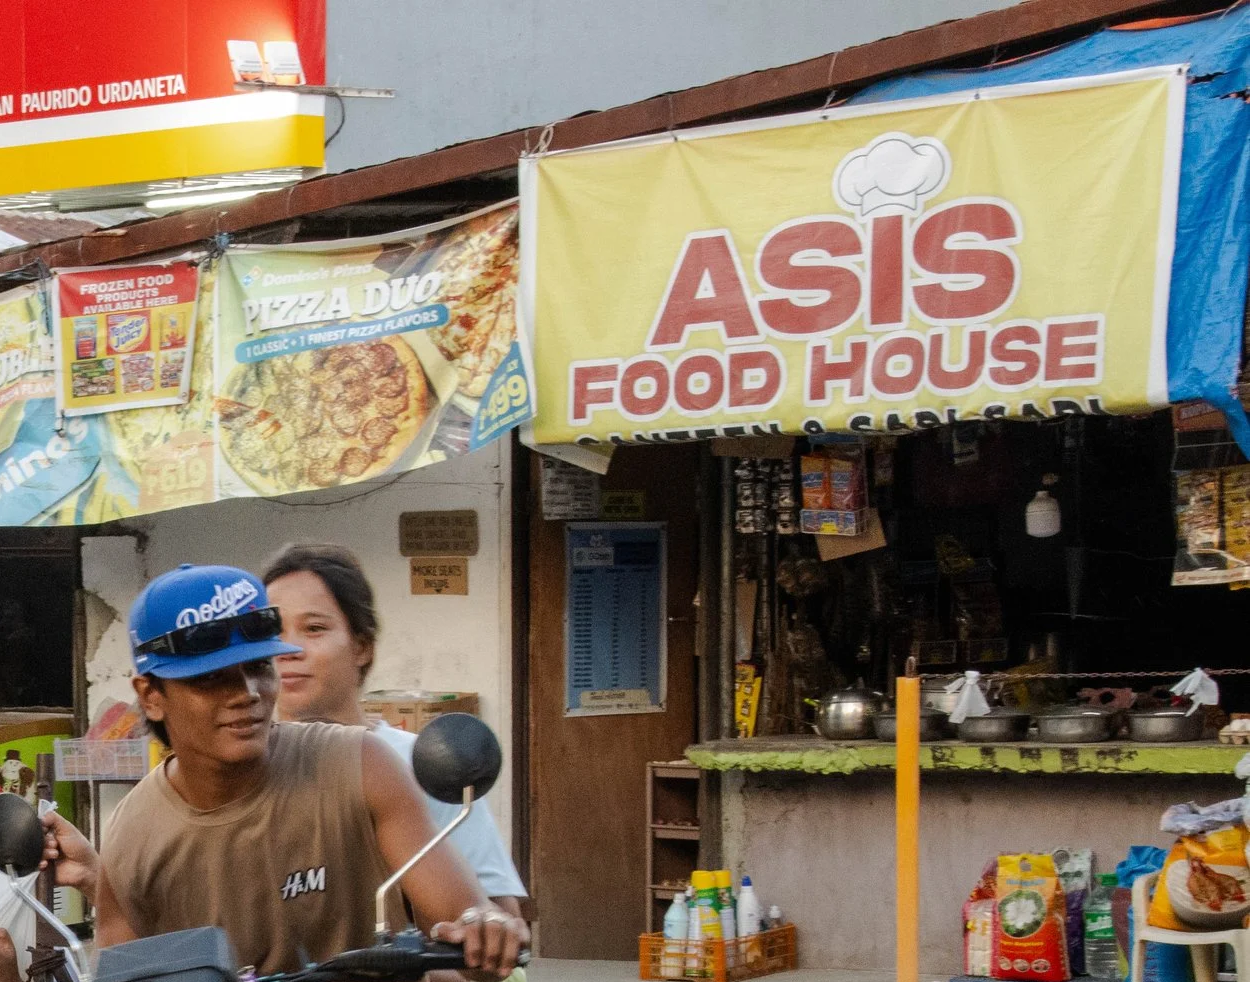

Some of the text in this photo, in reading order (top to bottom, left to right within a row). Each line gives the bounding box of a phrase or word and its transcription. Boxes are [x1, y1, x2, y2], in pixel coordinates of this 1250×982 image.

[21, 85, 91, 115] PAURIDO
[97, 74, 187, 105] URDANETA
[79, 273, 175, 296] FROZEN FOOD
[647, 202, 1018, 348] ASIS
[82, 294, 179, 316] AVAILABLE HERE!
[95, 287, 160, 304] PRODUCTS
[241, 270, 445, 338] PIZZA DUO
[307, 328, 346, 346] FINEST
[347, 323, 383, 339] PIZZA
[383, 309, 440, 332] FLAVORS
[572, 319, 1099, 421] FOOD HOUSE
[176, 578, 258, 629] Dodgers
[281, 866, 326, 900] H&M
